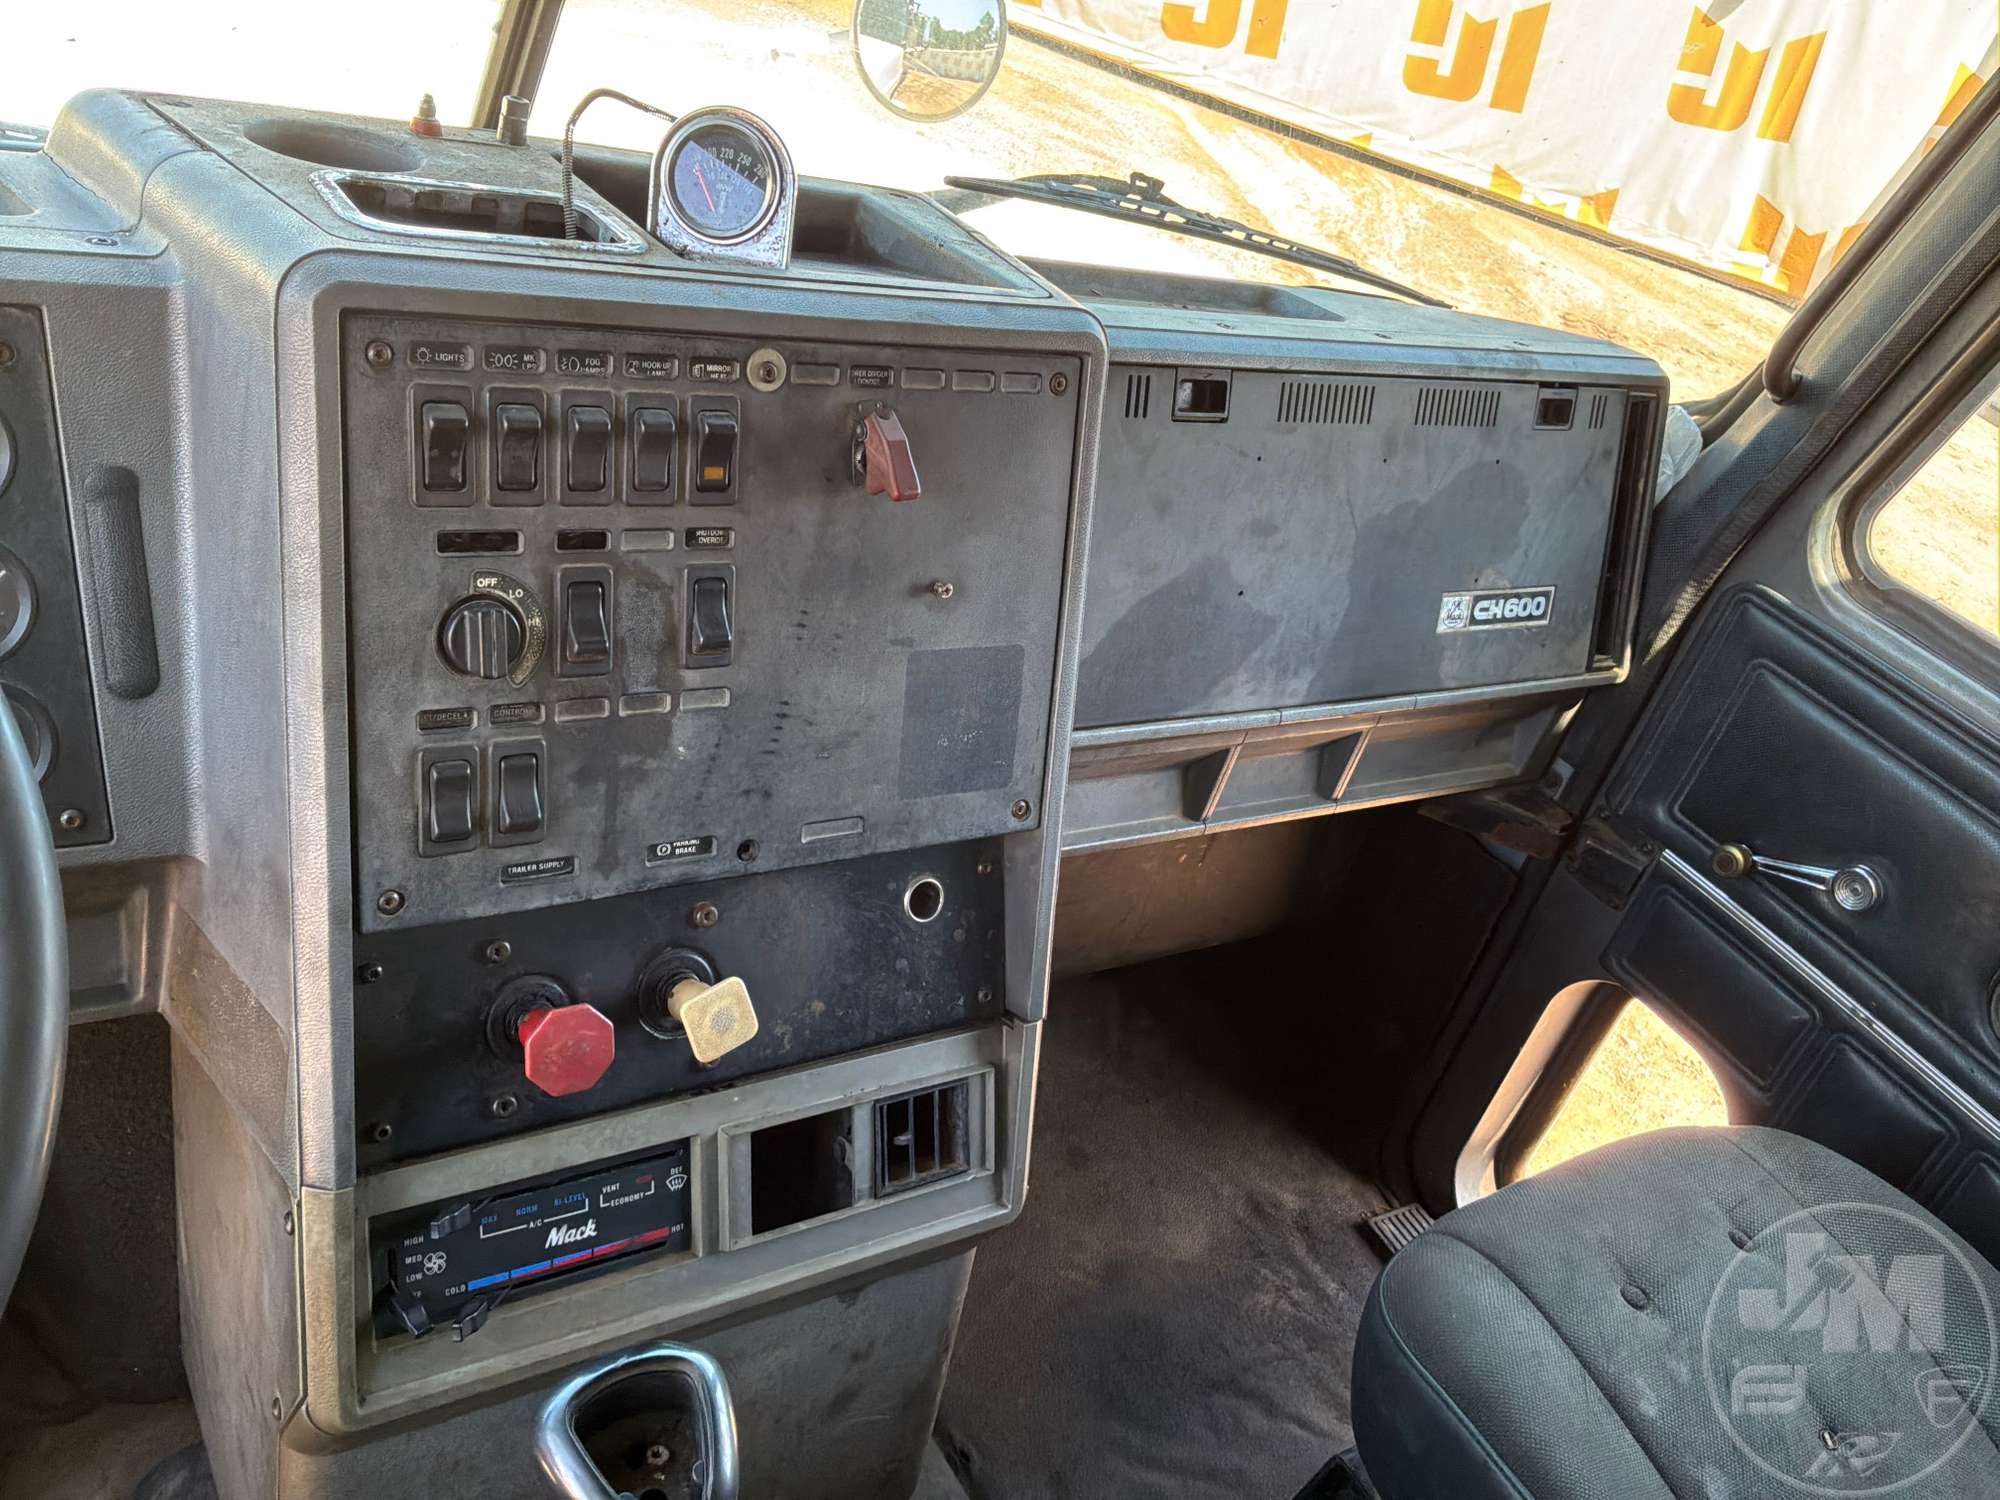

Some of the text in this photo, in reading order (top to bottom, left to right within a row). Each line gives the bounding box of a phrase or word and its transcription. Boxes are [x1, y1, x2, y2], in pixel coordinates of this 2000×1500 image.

[720, 147, 734, 160] 220
[434, 353, 465, 362] LIGHTS
[476, 577, 498, 588] OFF
[508, 588, 524, 599] LO
[1473, 596, 1546, 620] CH600
[675, 846, 697, 855] BRAKE
[508, 861, 565, 875] TRAILER SUPPLY
[602, 1182, 620, 1194] VENT
[610, 1192, 645, 1207] ECONOMY
[528, 1218, 543, 1229] A/C
[545, 1217, 598, 1249] Mack
[403, 1234, 424, 1247] HIGH
[405, 1253, 423, 1265] MED
[406, 1272, 423, 1283] LOW
[445, 1284, 467, 1297] COLD
